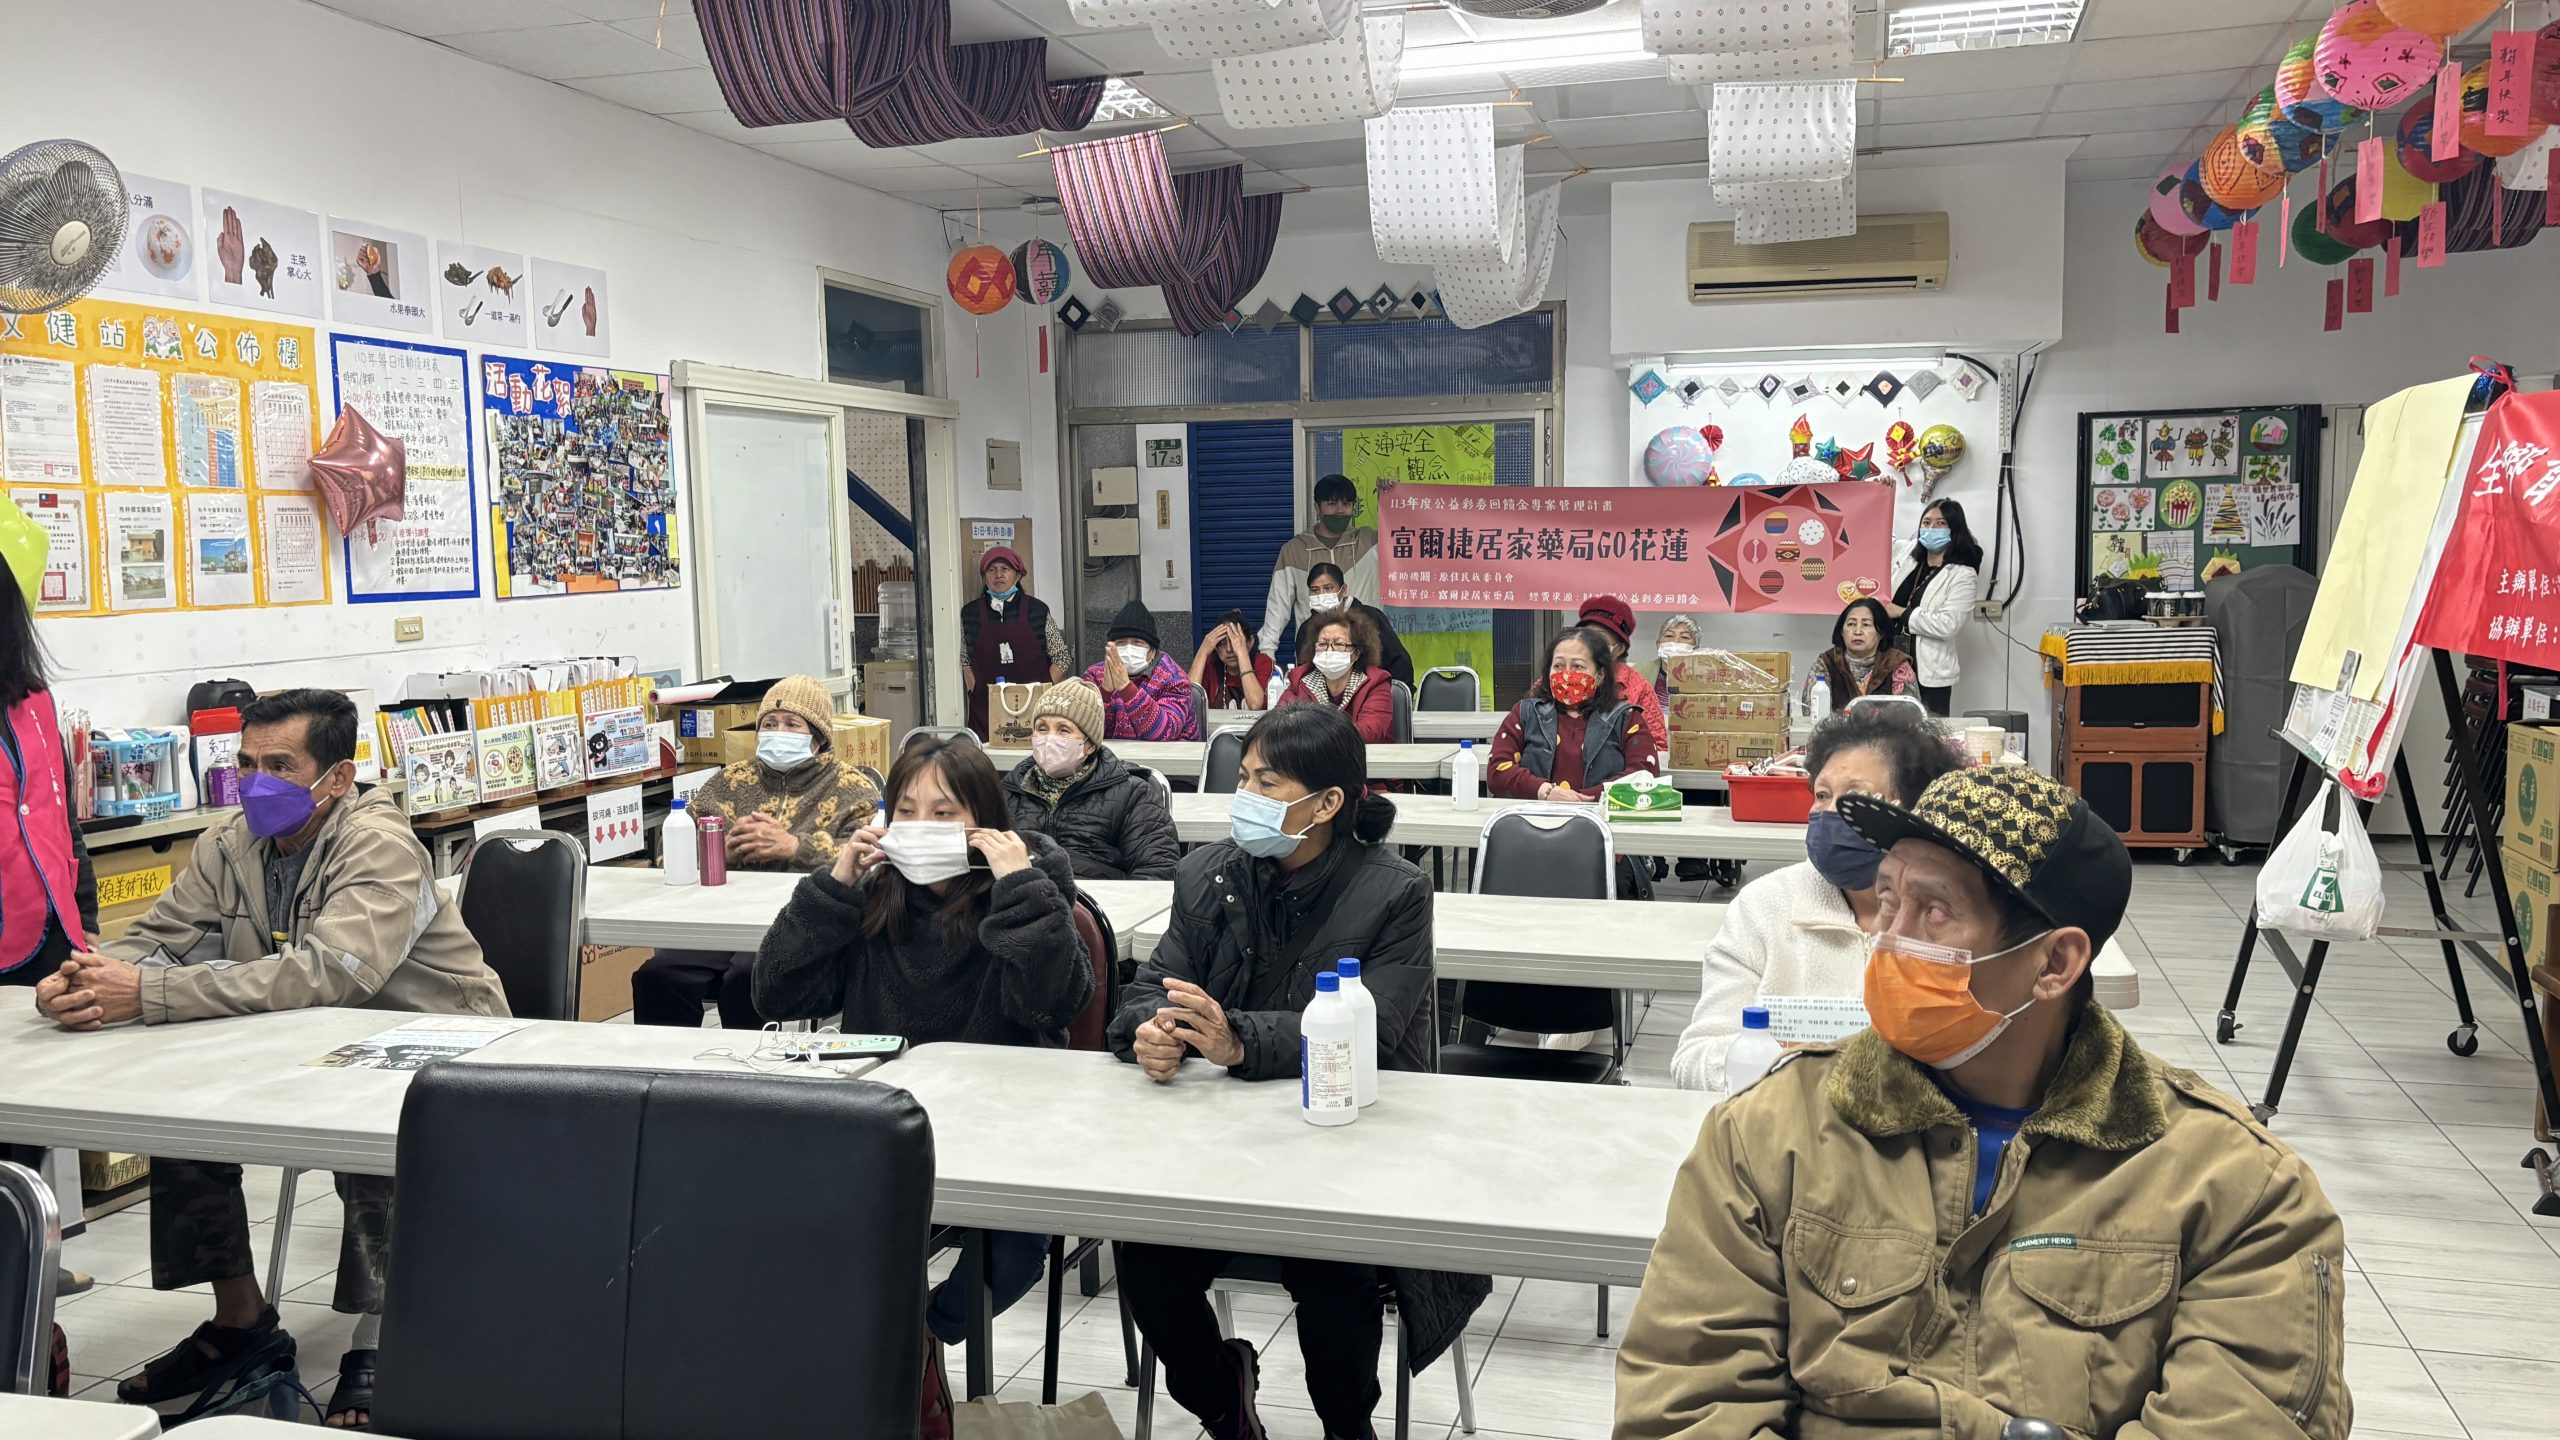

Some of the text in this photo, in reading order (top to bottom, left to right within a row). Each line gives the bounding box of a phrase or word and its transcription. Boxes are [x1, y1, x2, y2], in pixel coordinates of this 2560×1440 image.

[195, 329, 299, 368] 公佈欄
[486, 363, 572, 418] 活動花絮
[1354, 429, 1436, 457] 交通安全
[1405, 455, 1450, 480] 觀念
[1390, 526, 1689, 562] 富爾捷居家藥局GO花蓮
[2015, 1237, 2049, 1248] GARMENT
